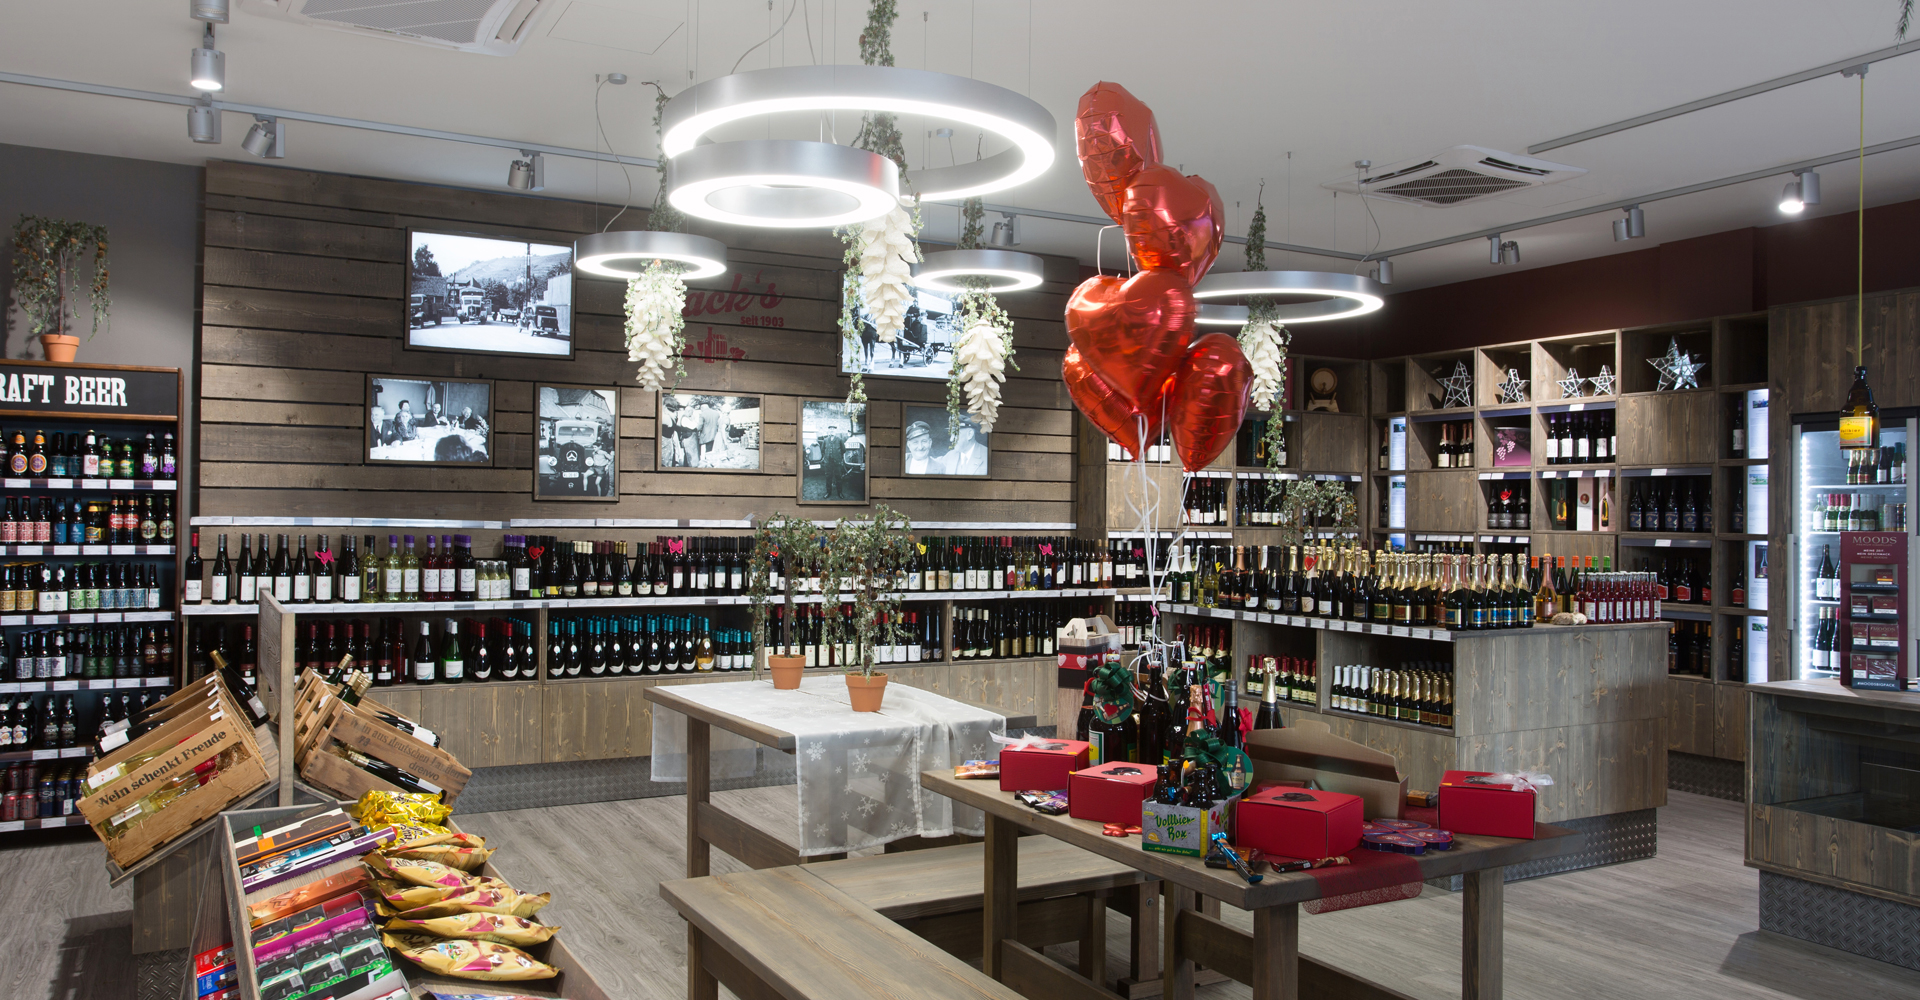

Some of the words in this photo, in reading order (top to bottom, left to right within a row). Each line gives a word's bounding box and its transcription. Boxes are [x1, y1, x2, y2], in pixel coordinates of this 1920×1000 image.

[681, 269, 785, 317] ack's
[740, 315, 759, 326] seit
[760, 316, 784, 328] 1903
[65, 375, 128, 406] BEER
[1852, 536, 1897, 544] MOODS
[357, 735, 371, 747] 73
[371, 729, 388, 743] aus
[387, 736, 430, 764] deutschen
[95, 784, 131, 809] Wein
[131, 756, 182, 791] schenkt
[179, 729, 227, 761] Freude
[1167, 826, 1188, 842] Box
